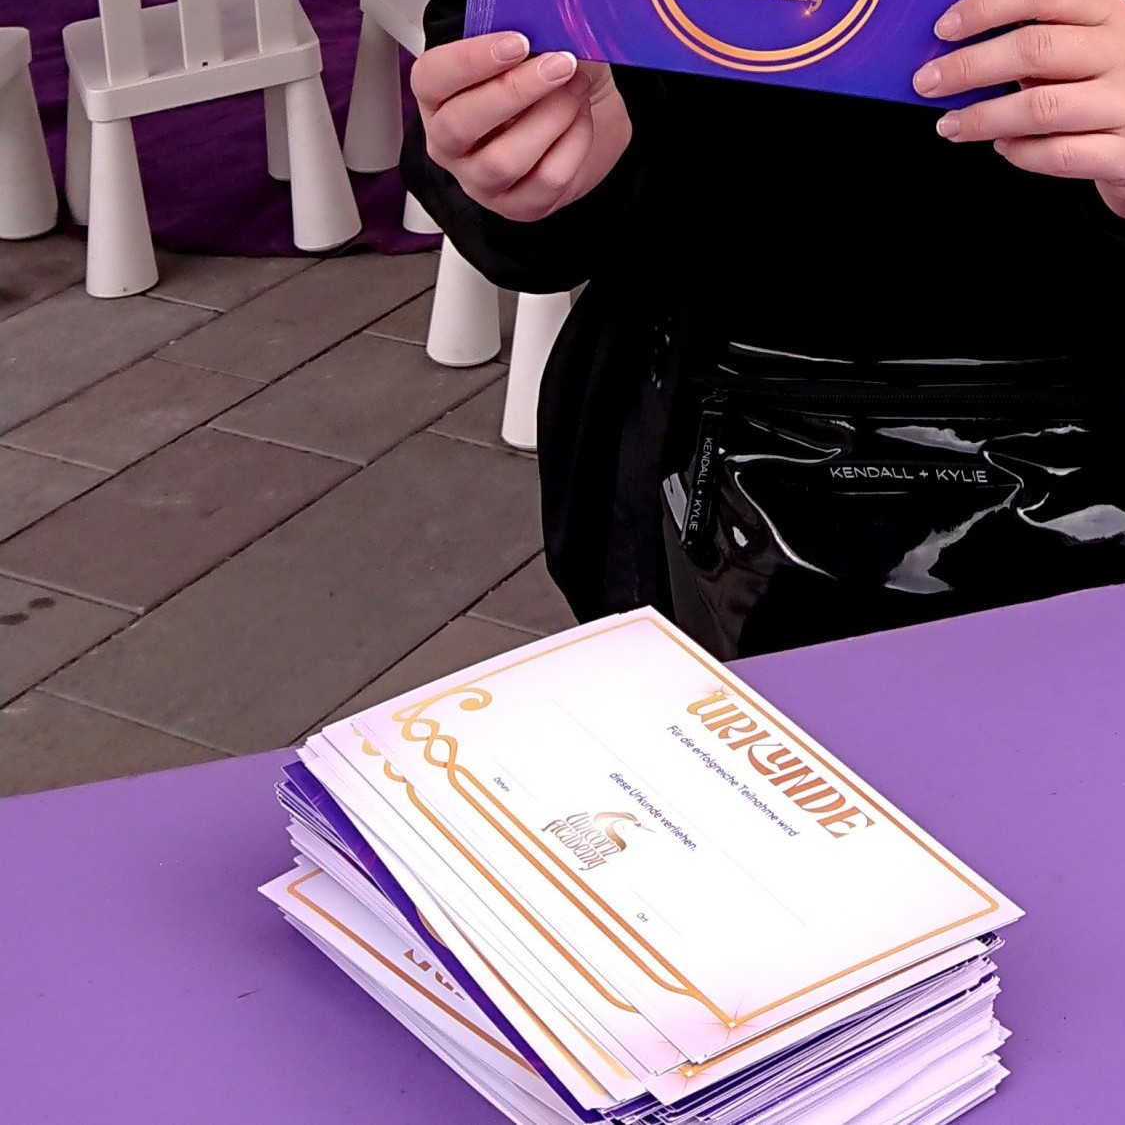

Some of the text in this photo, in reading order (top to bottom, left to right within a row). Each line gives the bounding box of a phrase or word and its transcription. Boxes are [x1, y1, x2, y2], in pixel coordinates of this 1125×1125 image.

[697, 437, 714, 485] KENDALL
[830, 467, 914, 479] KENDALL
[935, 469, 988, 483] KYLIE
[688, 499, 703, 531] KYLIE
[667, 725, 800, 837] Für die erfolgreiche Teilnahme wird
[566, 812, 620, 857] Unicorn
[609, 772, 697, 852] diese Urkunde verliehen.
[541, 819, 607, 871] Academy
